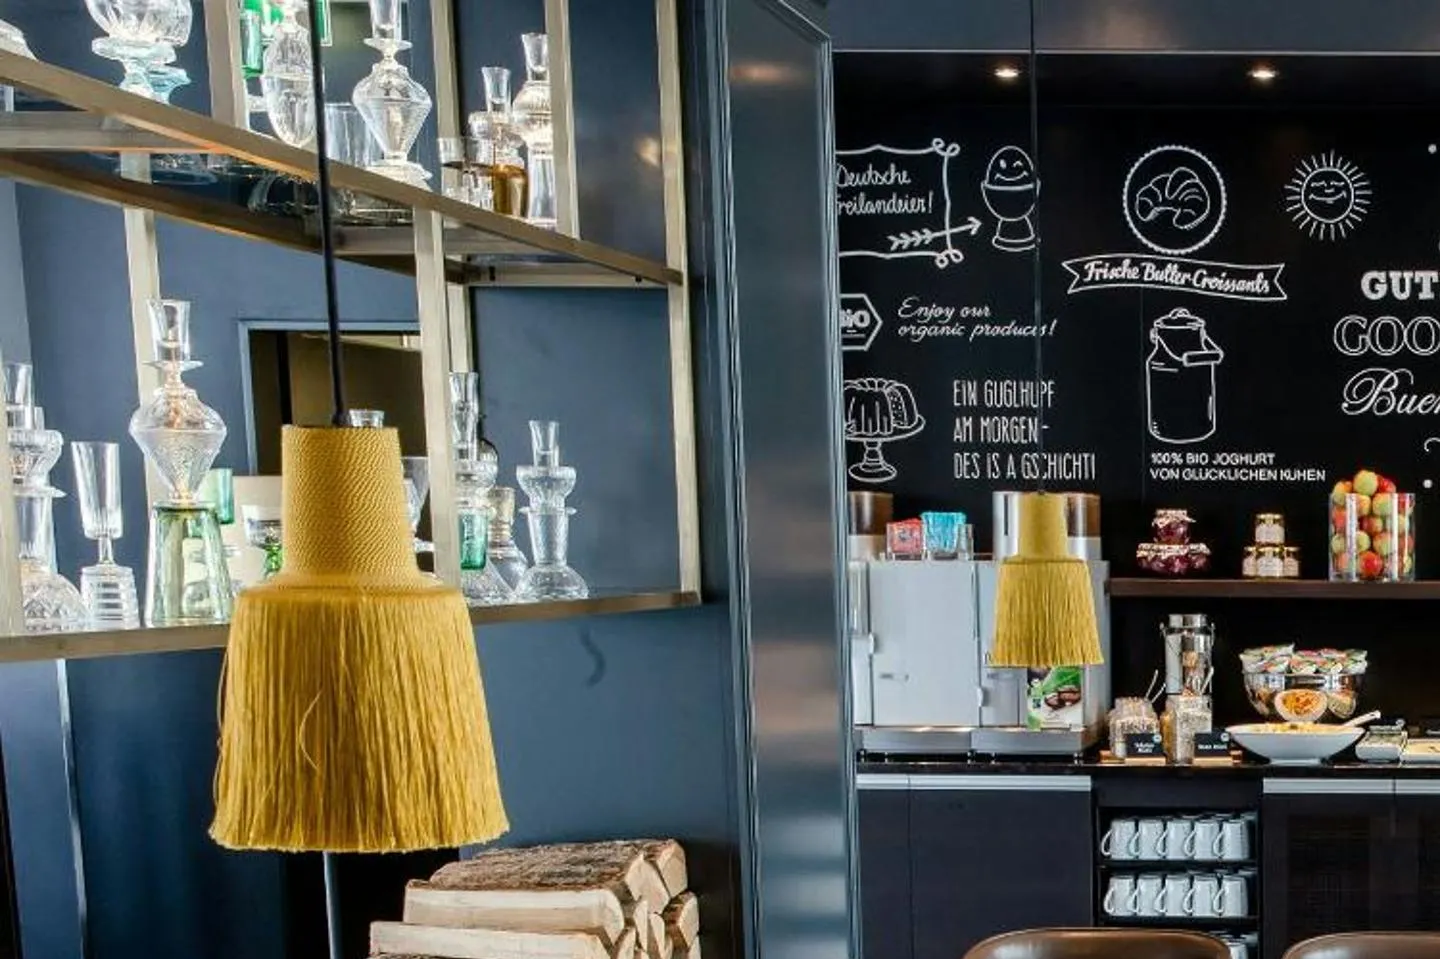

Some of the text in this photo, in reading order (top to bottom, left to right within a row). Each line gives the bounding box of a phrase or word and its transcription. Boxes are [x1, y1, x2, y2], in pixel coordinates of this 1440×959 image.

[836, 163, 912, 186] Deutsche
[836, 191, 934, 216] reilandeier!
[1083, 259, 1140, 282] Frische
[897, 296, 992, 324] Enjoy our
[897, 319, 1058, 342] organic products!
[984, 379, 1056, 408] GUGLHUPF
[953, 416, 973, 443] AM
[980, 416, 1039, 444] MORGEN
[953, 452, 981, 479] DES
[1006, 452, 1017, 480] A
[1151, 453, 1276, 466] 100% BIO JOGHURT
[1150, 468, 1180, 481] VON
